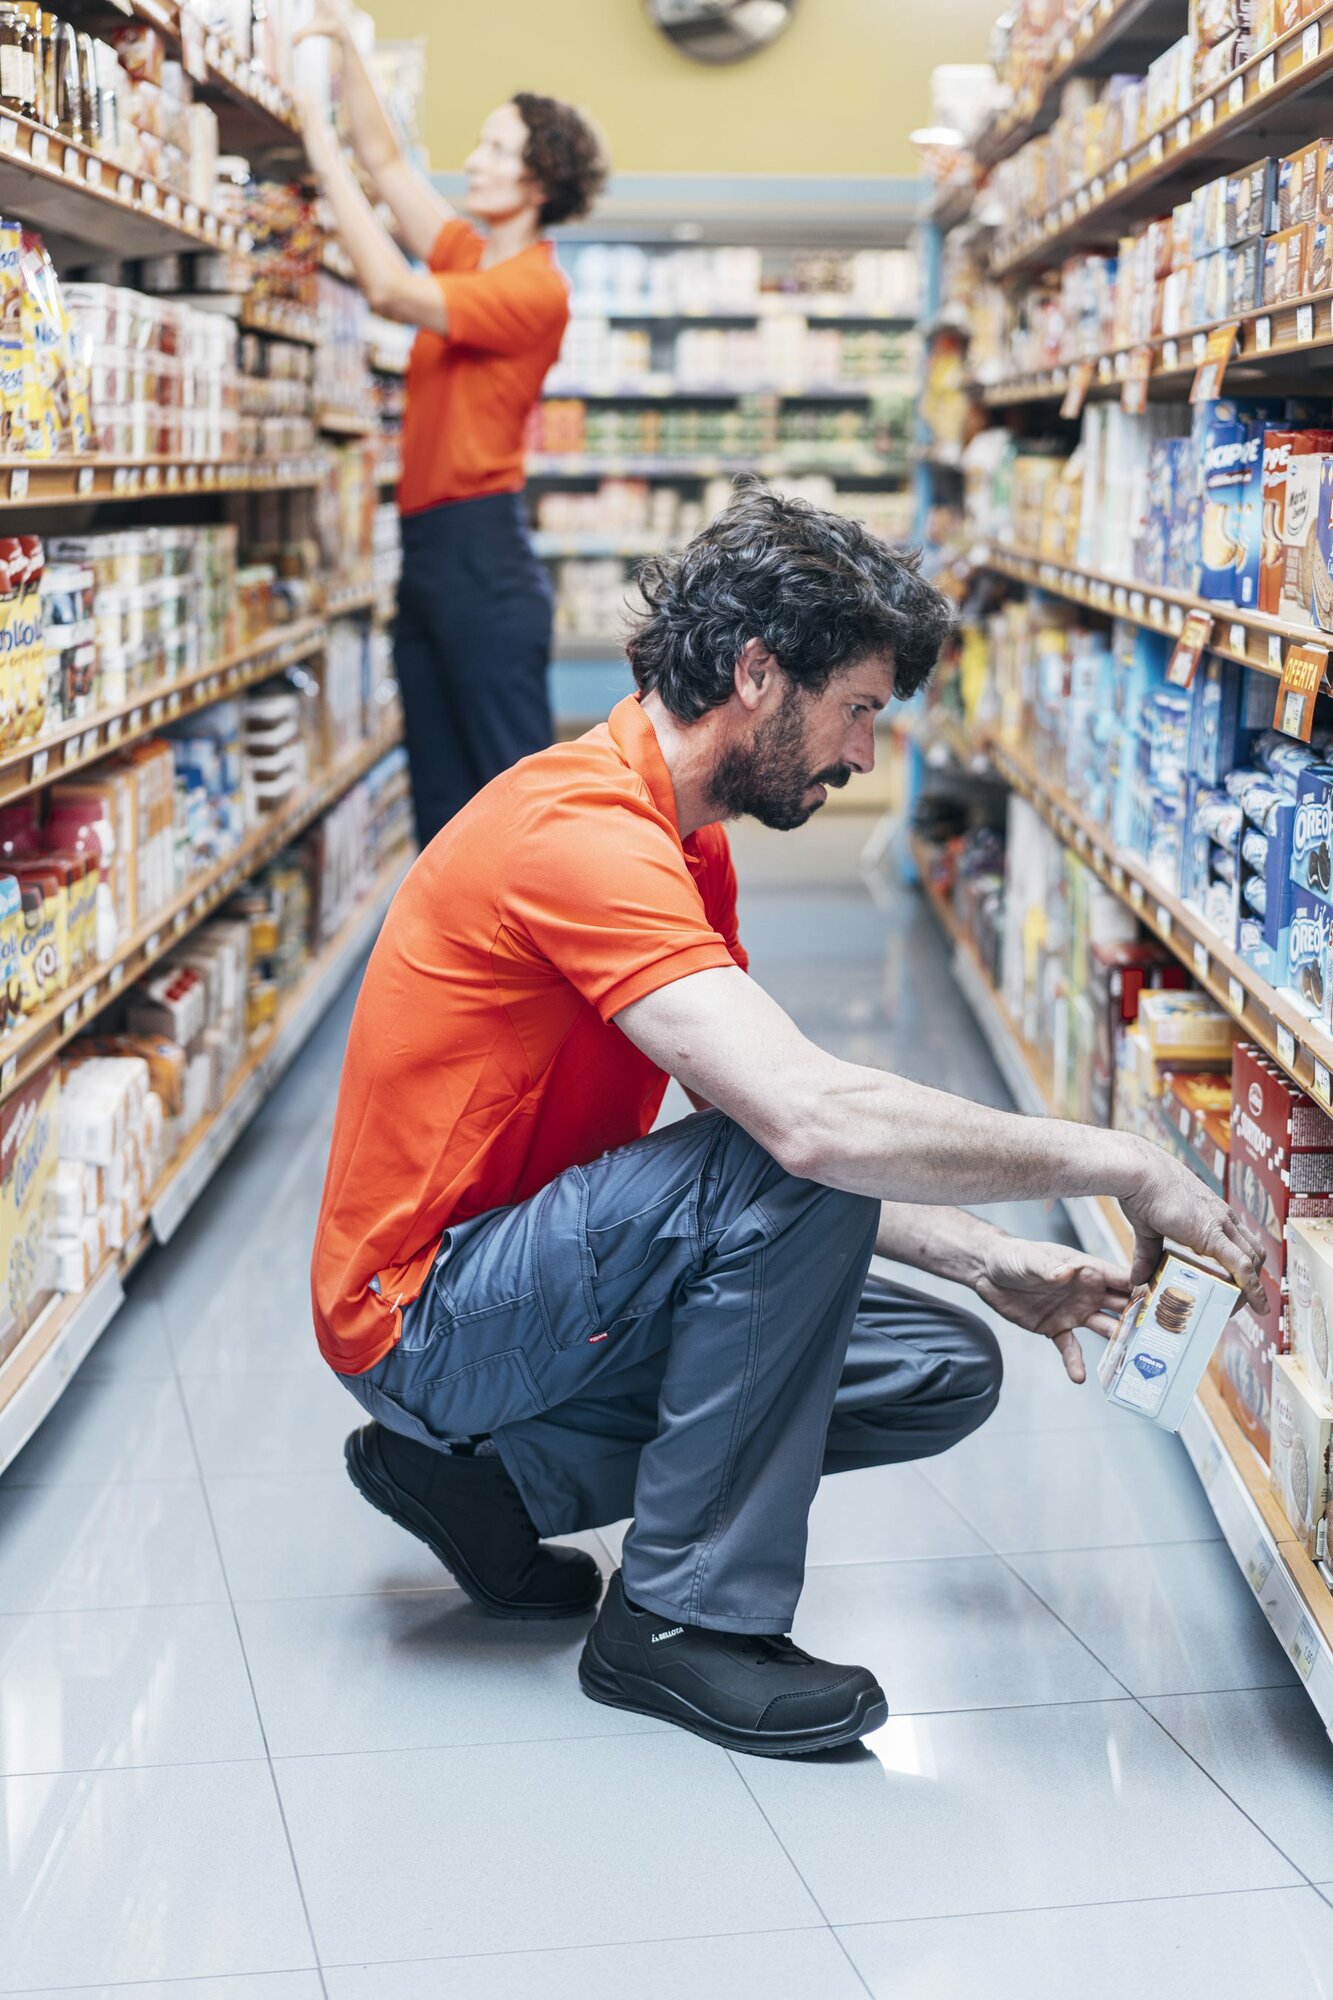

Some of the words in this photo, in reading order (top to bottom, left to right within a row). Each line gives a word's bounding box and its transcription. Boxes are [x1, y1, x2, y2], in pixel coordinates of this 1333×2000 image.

[1284, 658, 1319, 692] OFERTA
[1295, 809, 1329, 850] OREO
[1289, 924, 1321, 962] OREO
[658, 1626, 685, 1641] BELLOTA
